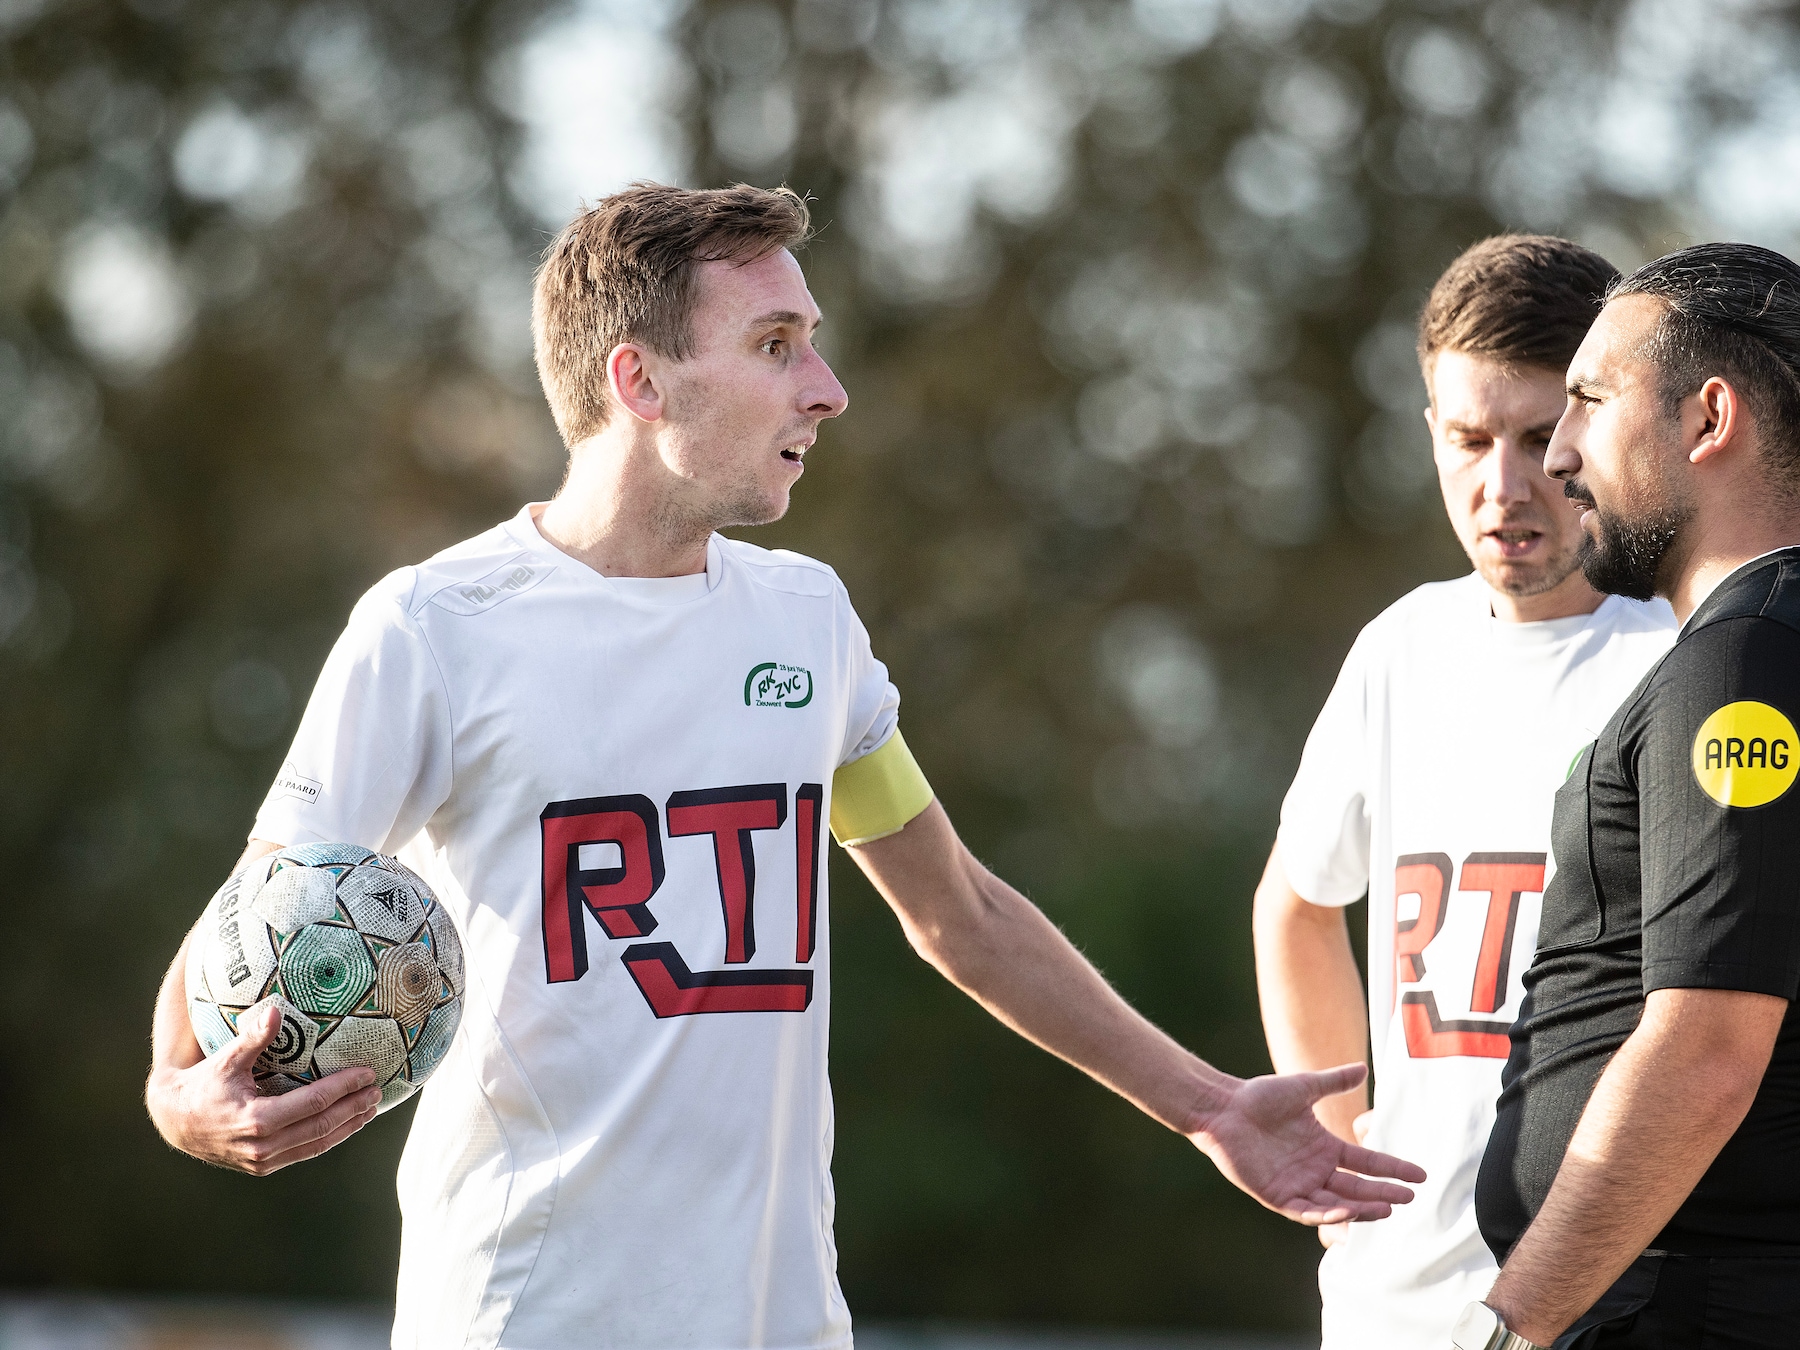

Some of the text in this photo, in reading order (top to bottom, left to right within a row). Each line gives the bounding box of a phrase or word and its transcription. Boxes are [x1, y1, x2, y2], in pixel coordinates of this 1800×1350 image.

[774, 674, 801, 700] ZVC
[1705, 737, 1789, 770] ARAG
[285, 779, 317, 796] PAARD
[540, 783, 823, 1019] RTI
[1391, 852, 1547, 1058] RT
